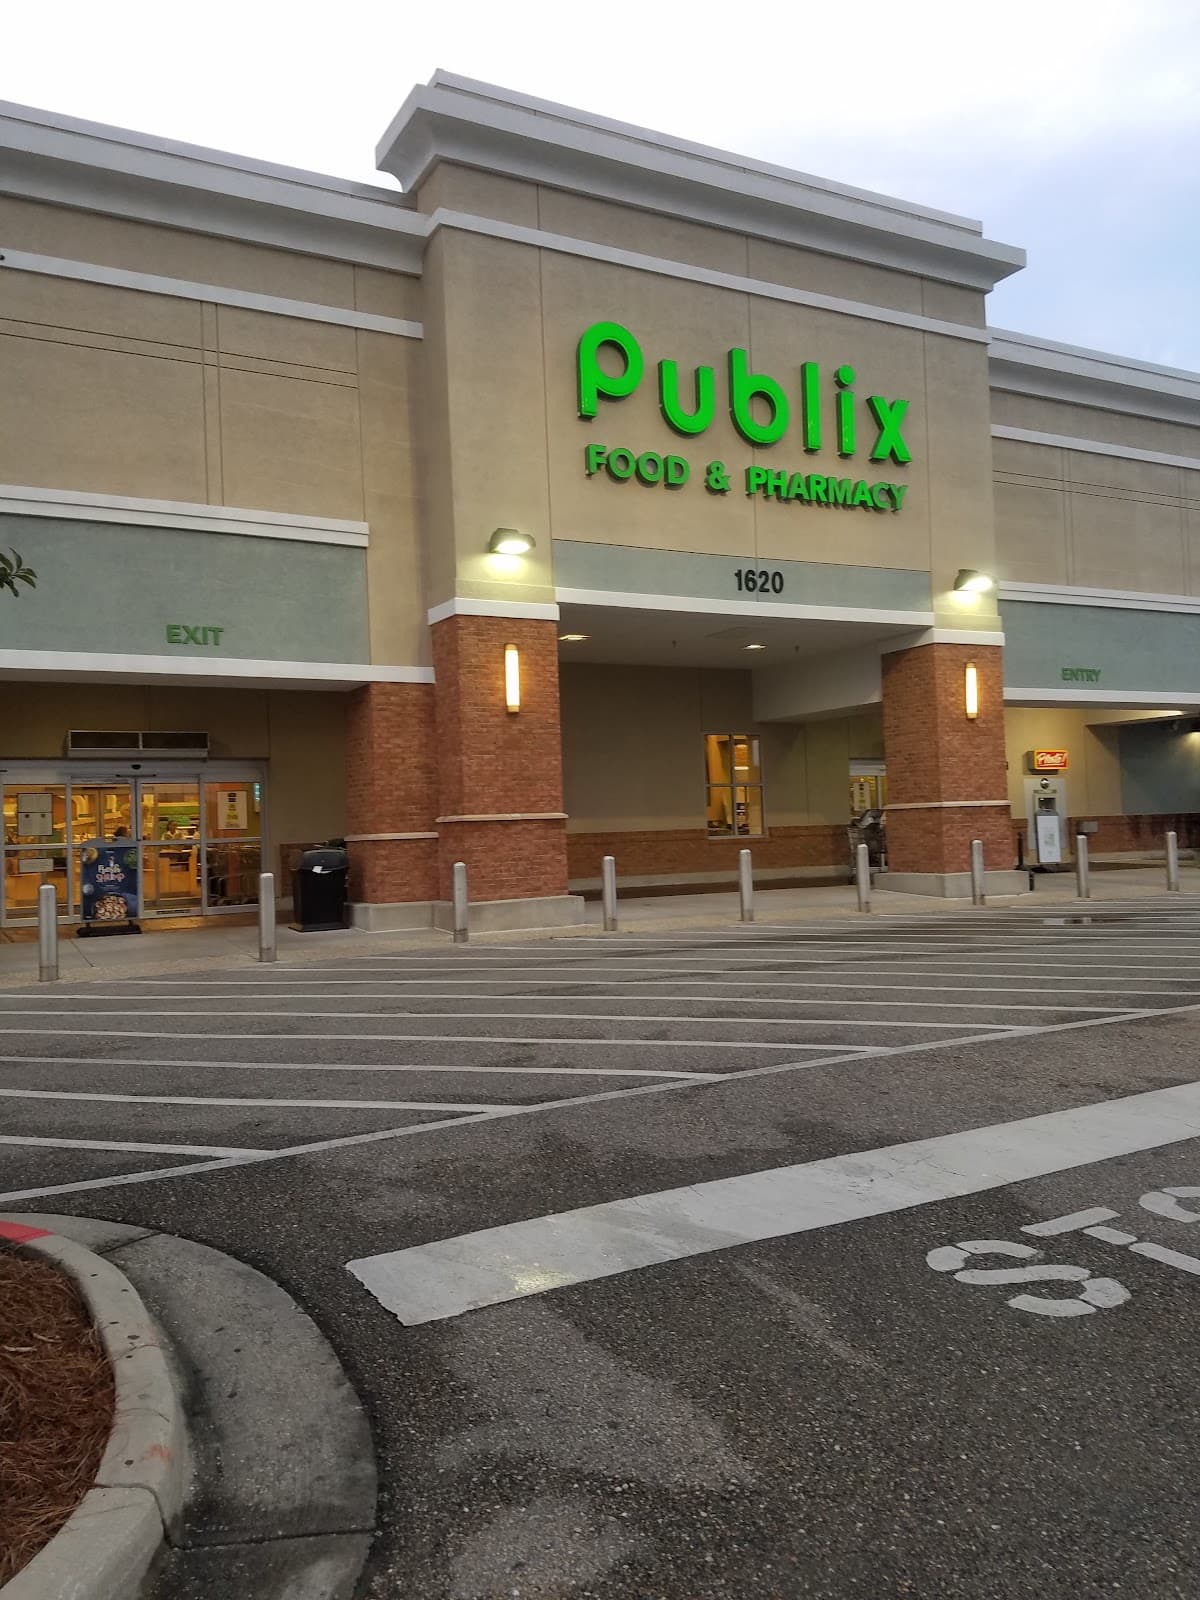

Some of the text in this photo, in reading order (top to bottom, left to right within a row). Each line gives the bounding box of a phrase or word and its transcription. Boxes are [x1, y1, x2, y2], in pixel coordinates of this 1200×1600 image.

[577, 321, 912, 463] Publix
[585, 444, 908, 511] FOOD & PHARMACY
[734, 568, 784, 594] 1620
[166, 624, 224, 646] EXIT
[1061, 667, 1101, 683] ENTRY
